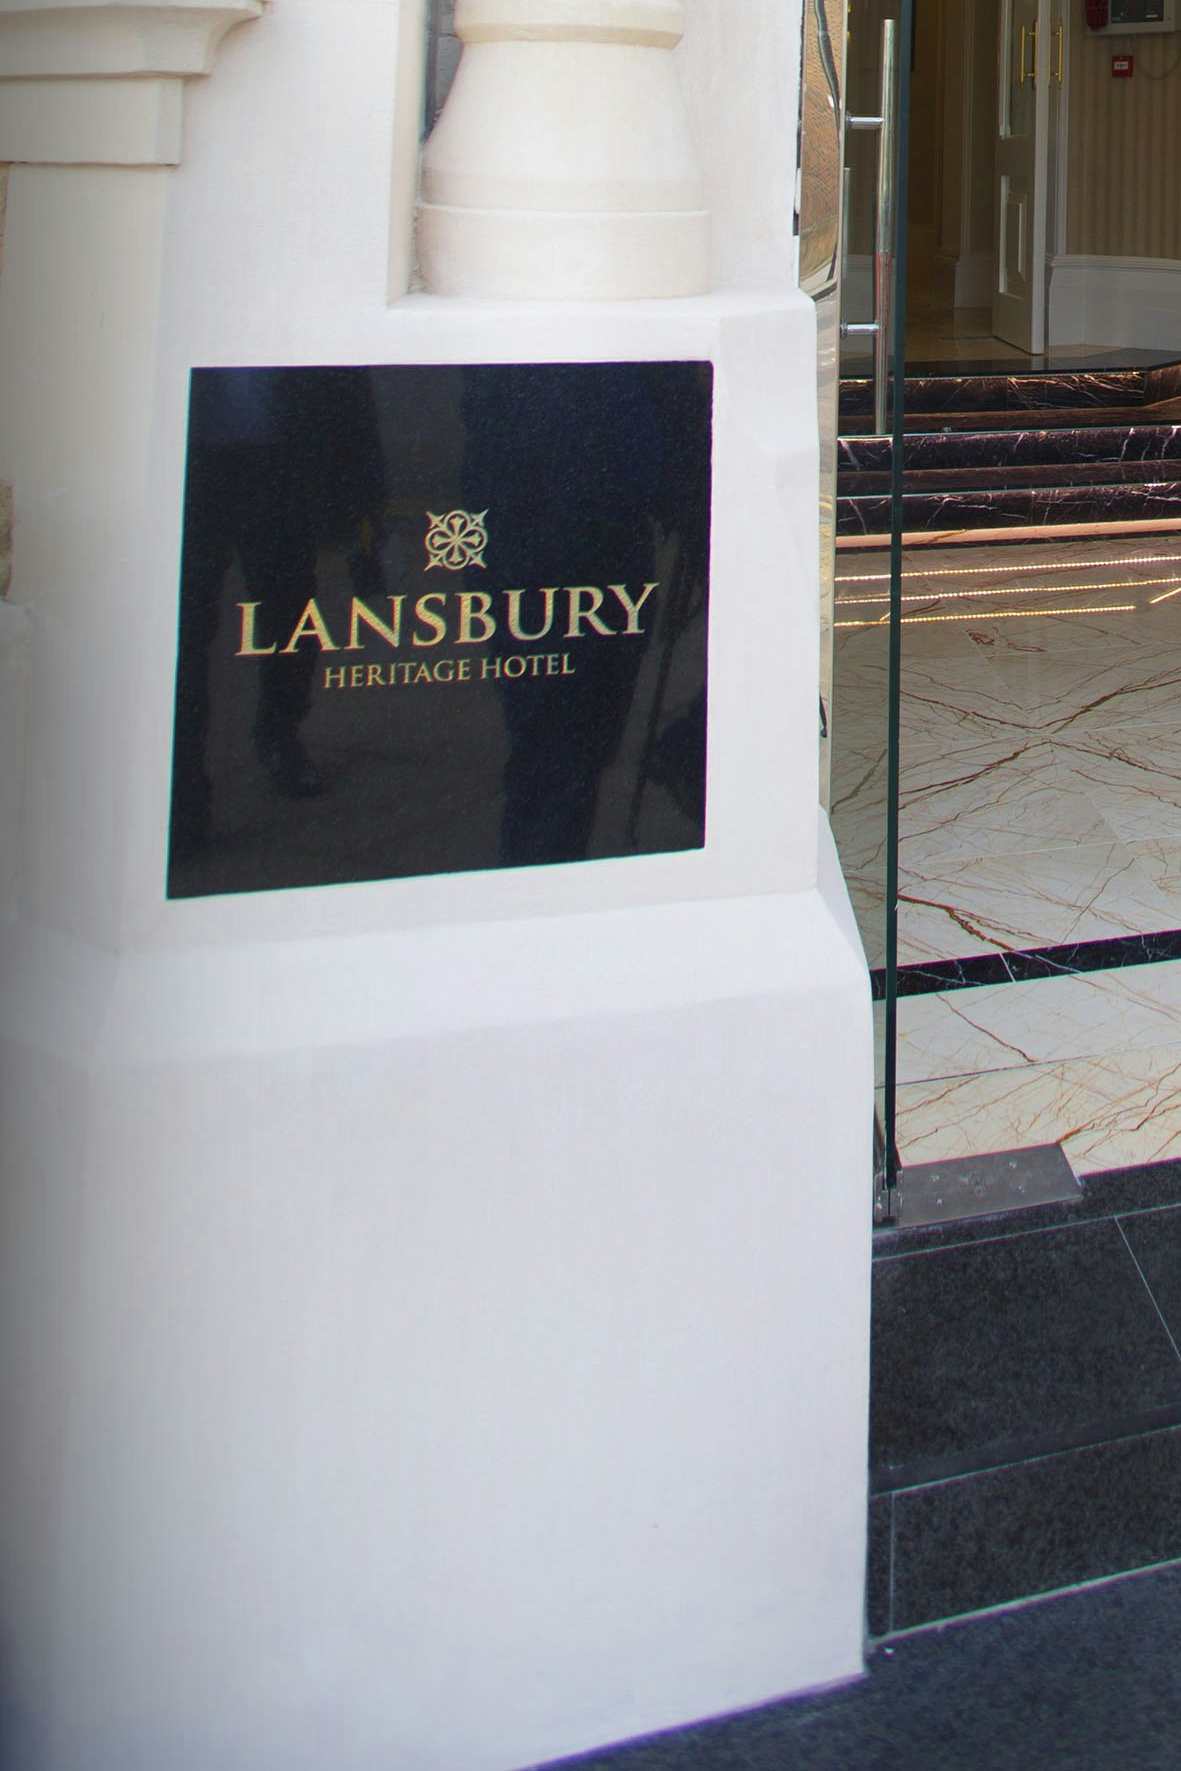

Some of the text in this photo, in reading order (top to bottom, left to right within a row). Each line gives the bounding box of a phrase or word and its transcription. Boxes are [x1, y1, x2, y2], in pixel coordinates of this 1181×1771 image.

[234, 582, 660, 656] LANSBURY
[323, 653, 576, 689] HERITAGE HOTEL
